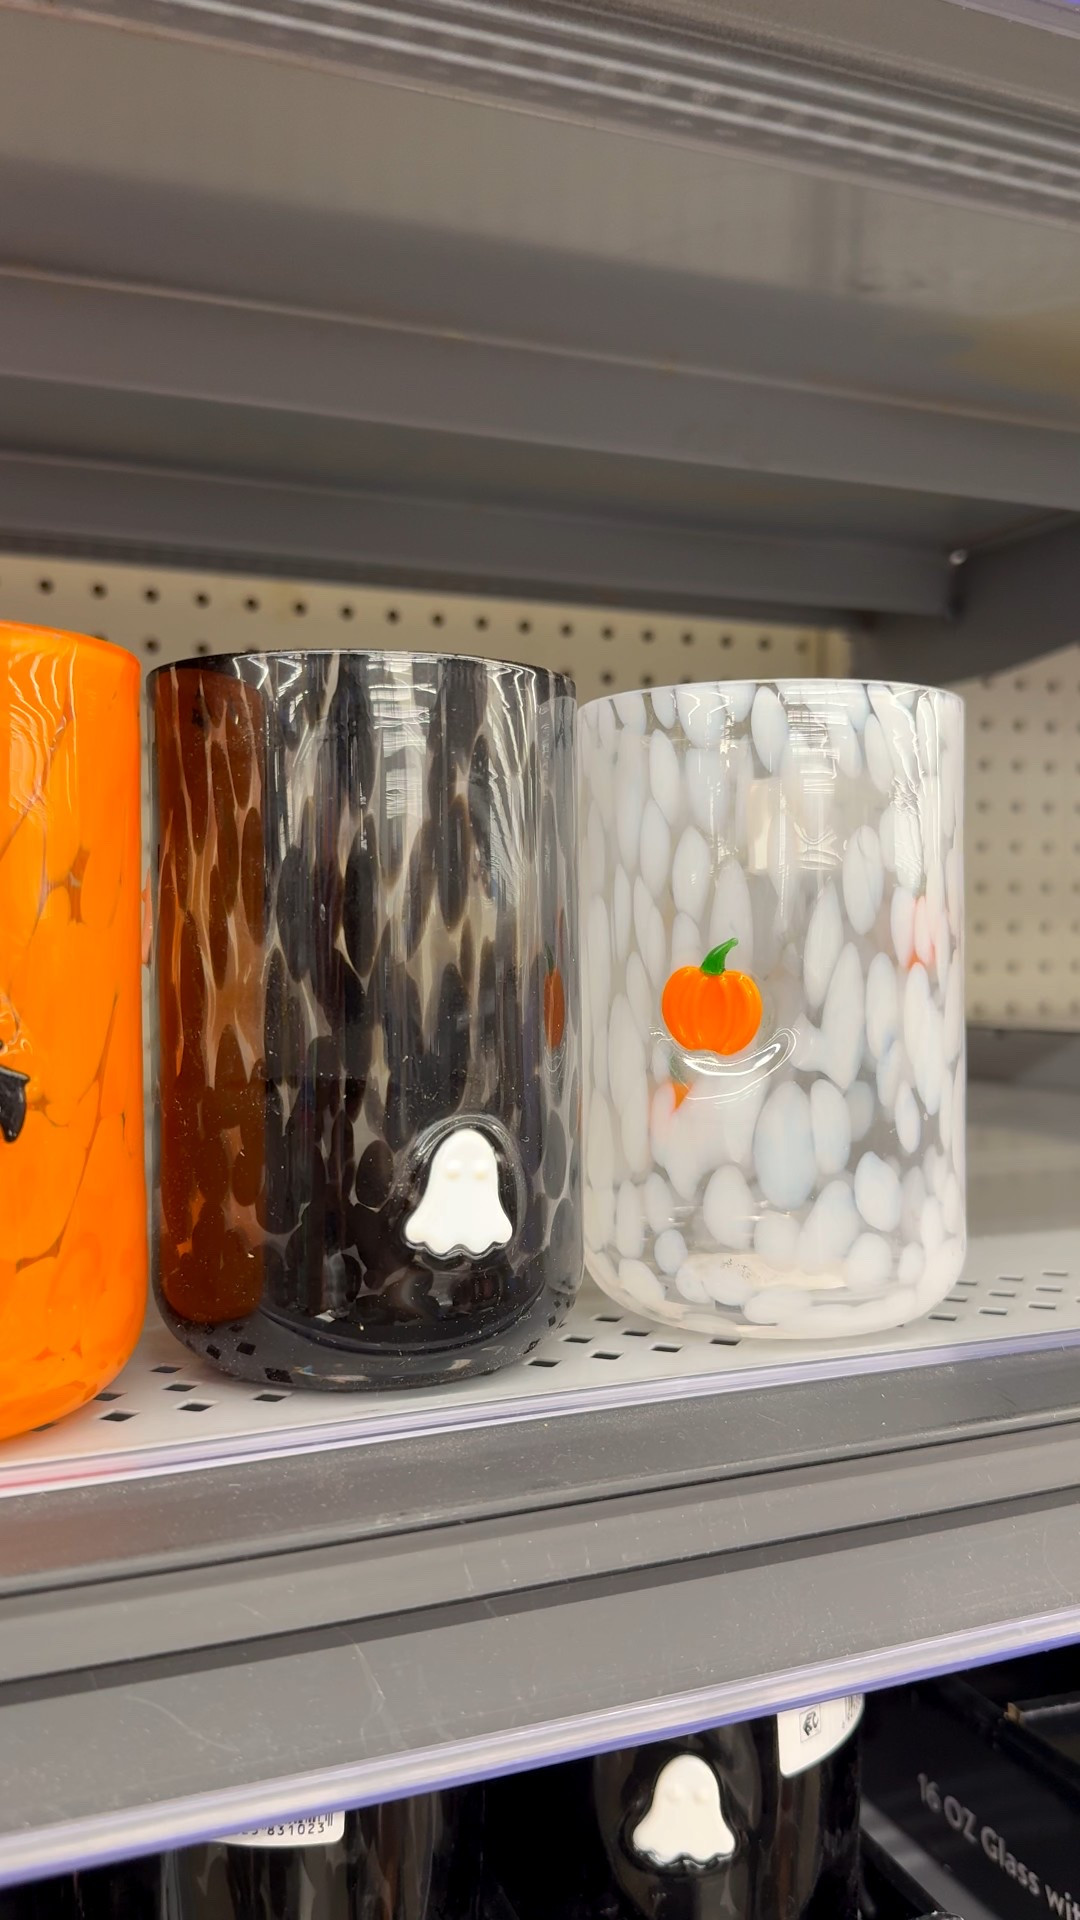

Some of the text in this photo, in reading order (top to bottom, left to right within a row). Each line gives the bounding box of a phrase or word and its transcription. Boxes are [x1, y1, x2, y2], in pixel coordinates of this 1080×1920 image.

[917, 1772, 941, 1813] 16
[943, 1795, 977, 1844] OZ
[980, 1826, 1041, 1896] Glass
